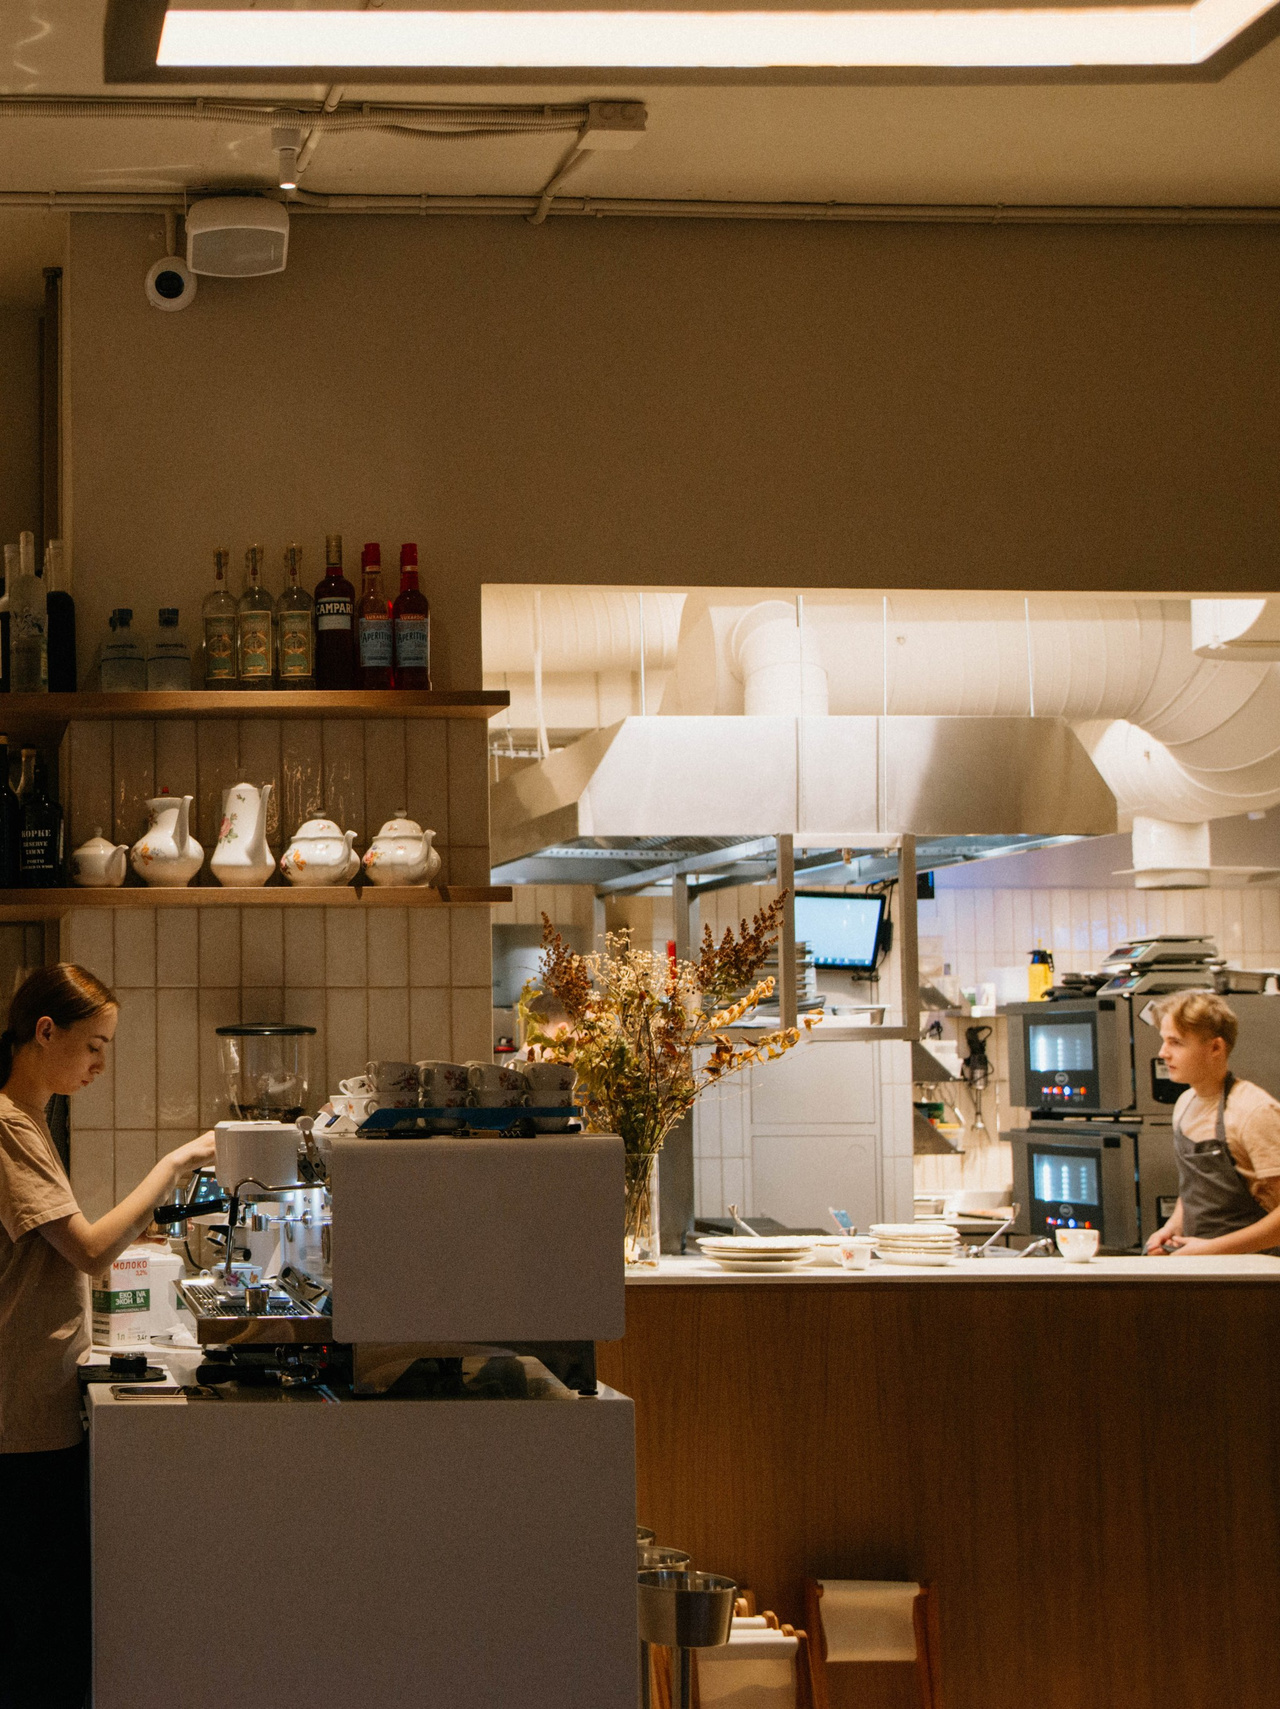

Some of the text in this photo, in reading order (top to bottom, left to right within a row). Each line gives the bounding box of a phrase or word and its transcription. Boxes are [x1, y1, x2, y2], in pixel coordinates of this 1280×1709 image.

[316, 603, 353, 615] CAMPARI
[21, 829, 51, 838] KOPKE
[113, 1260, 148, 1270] МОЛОКО
